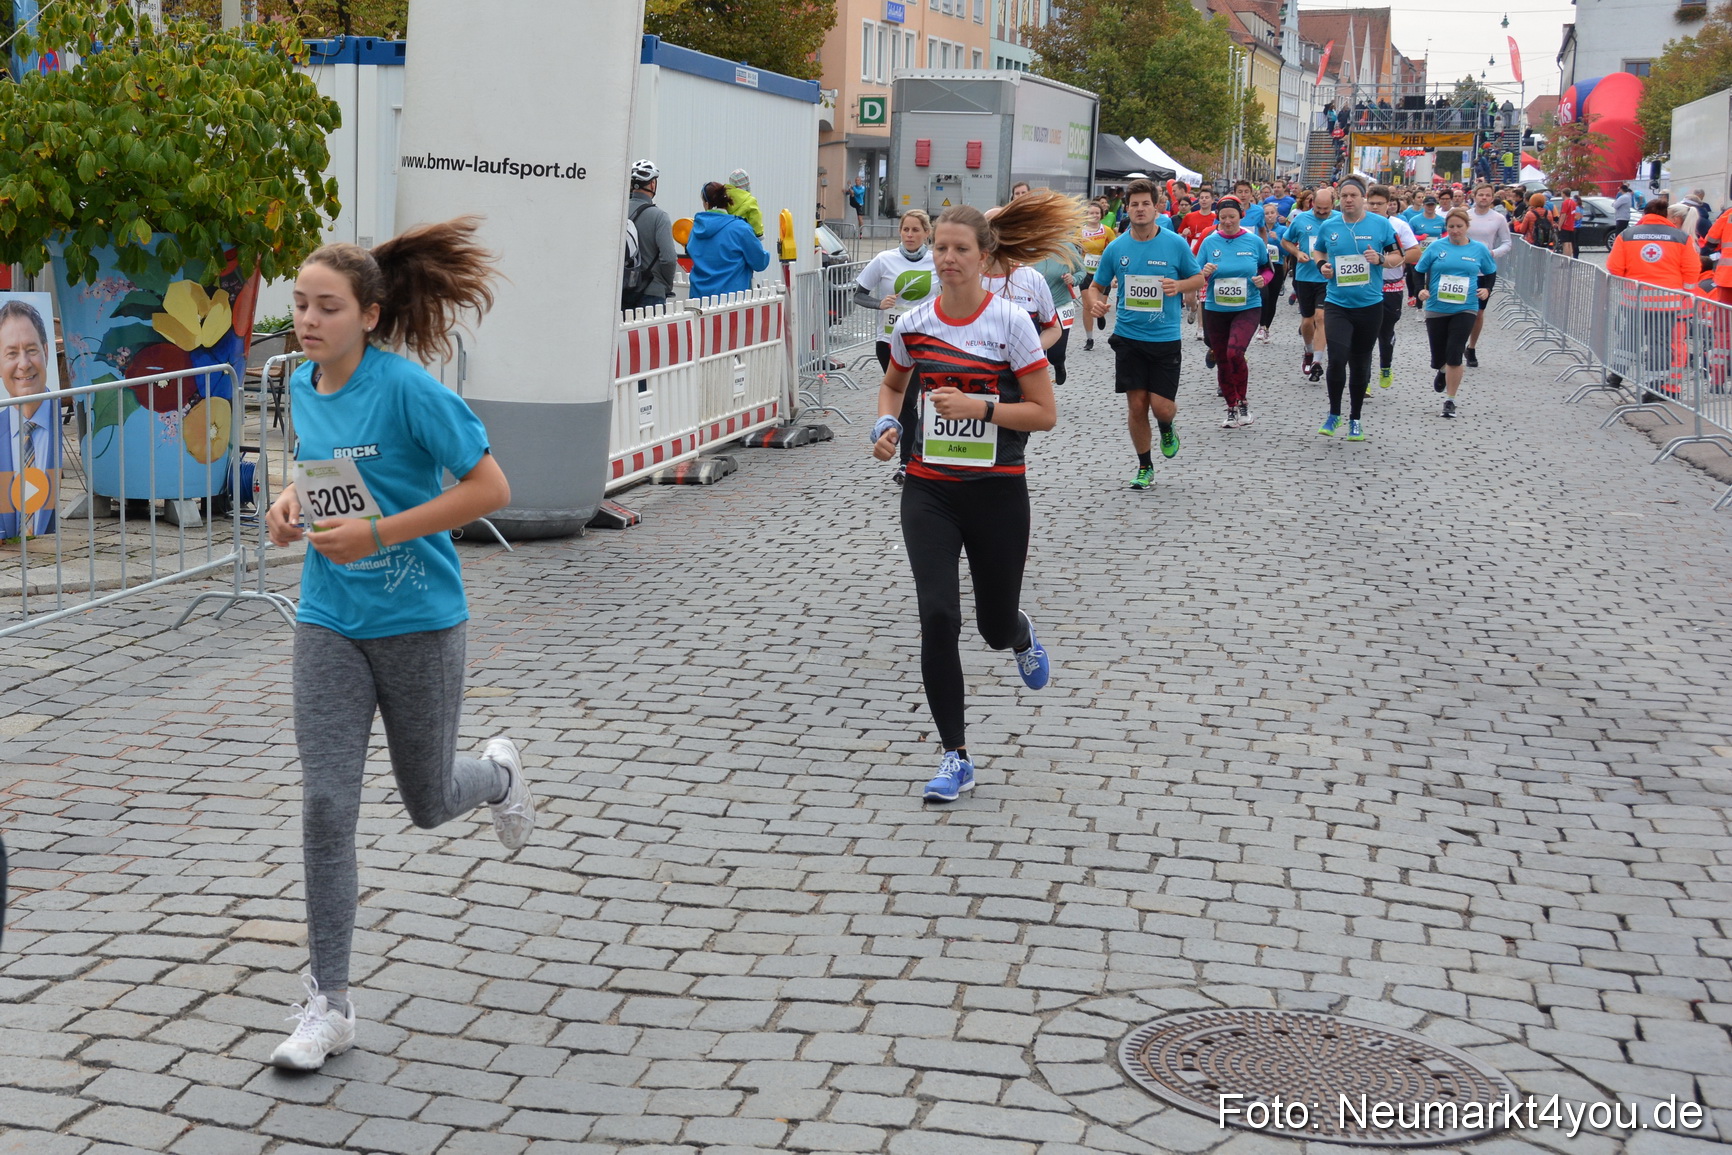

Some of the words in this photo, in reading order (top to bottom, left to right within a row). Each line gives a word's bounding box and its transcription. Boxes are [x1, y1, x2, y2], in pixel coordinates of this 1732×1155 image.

[863, 101, 882, 120] D
[1400, 135, 1427, 145] ZIEL
[401, 152, 587, 180] www.bmw-laufsport.de
[1340, 264, 1365, 274] 5236
[1130, 286, 1158, 297] 5090
[1218, 286, 1242, 295] 5235
[1441, 283, 1464, 293] 5165
[965, 340, 999, 349] NEUMARKT
[933, 414, 986, 438] 5020
[333, 444, 379, 459] BOCK
[948, 444, 967, 453] Anke
[306, 484, 366, 518] 5205
[344, 555, 392, 571] Stadtlauf
